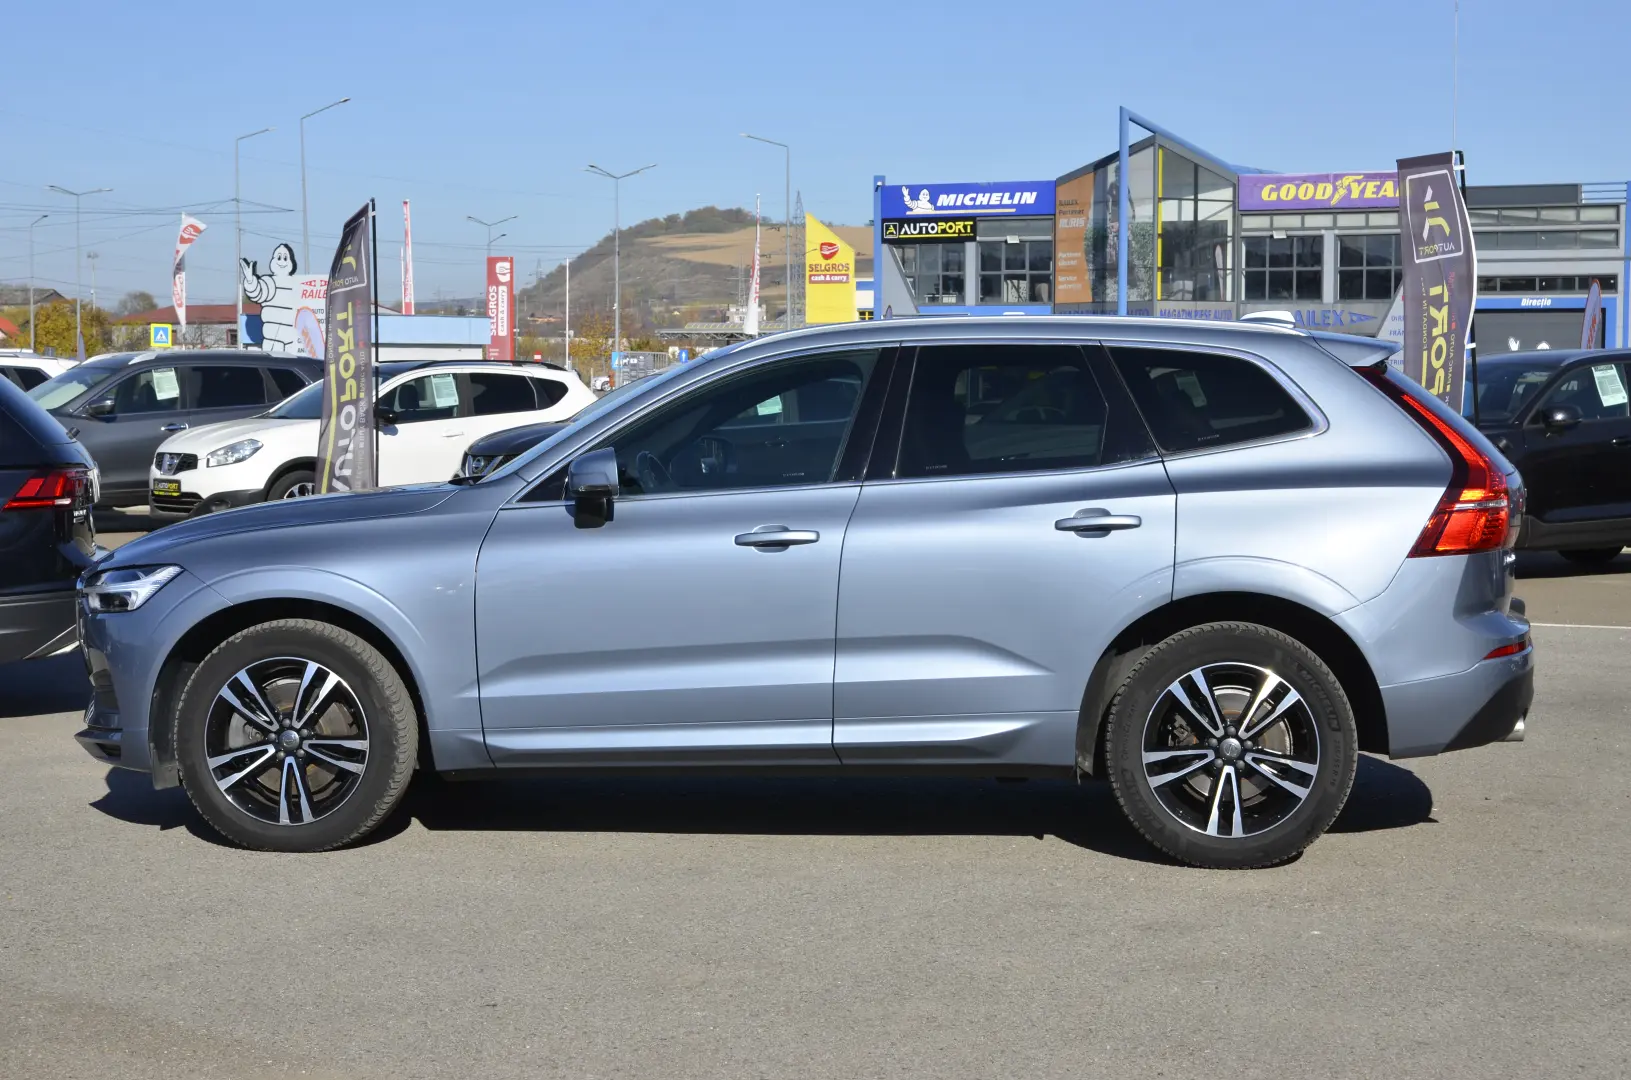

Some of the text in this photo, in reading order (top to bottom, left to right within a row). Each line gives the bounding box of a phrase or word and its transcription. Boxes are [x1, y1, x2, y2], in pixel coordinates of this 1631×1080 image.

[936, 192, 1038, 207] MICHELIN
[900, 221, 974, 235] AUTOPORT
[808, 263, 850, 272] SELGROS
[301, 289, 327, 299] RAILE
[1294, 309, 1346, 327] AILEX
